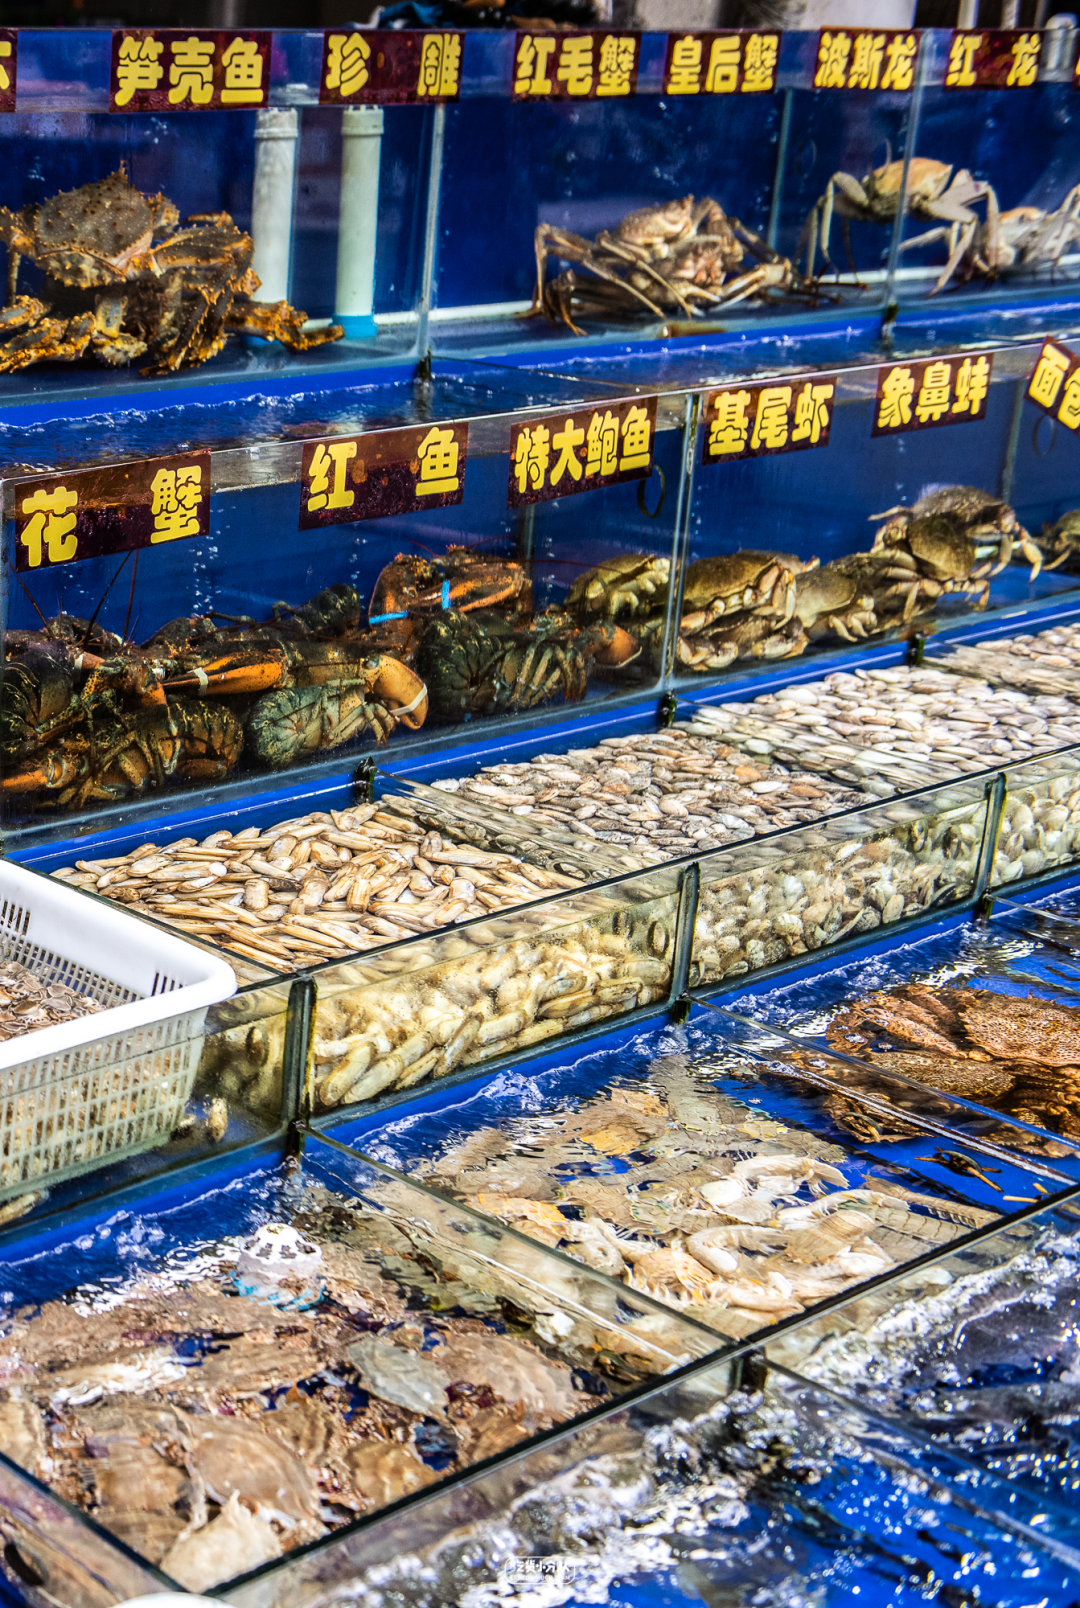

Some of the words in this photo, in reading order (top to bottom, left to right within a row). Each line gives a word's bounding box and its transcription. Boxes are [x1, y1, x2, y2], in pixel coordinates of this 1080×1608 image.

[115, 37, 263, 106] 笋壳鱼
[514, 35, 635, 95] 红毛蟹
[667, 35, 777, 94] 皇后蟹
[814, 32, 916, 89] 波斯龙
[709, 383, 833, 455] 基尾虾
[877, 356, 988, 428] 象鼻蚌
[515, 406, 650, 493] 特大鲍鱼
